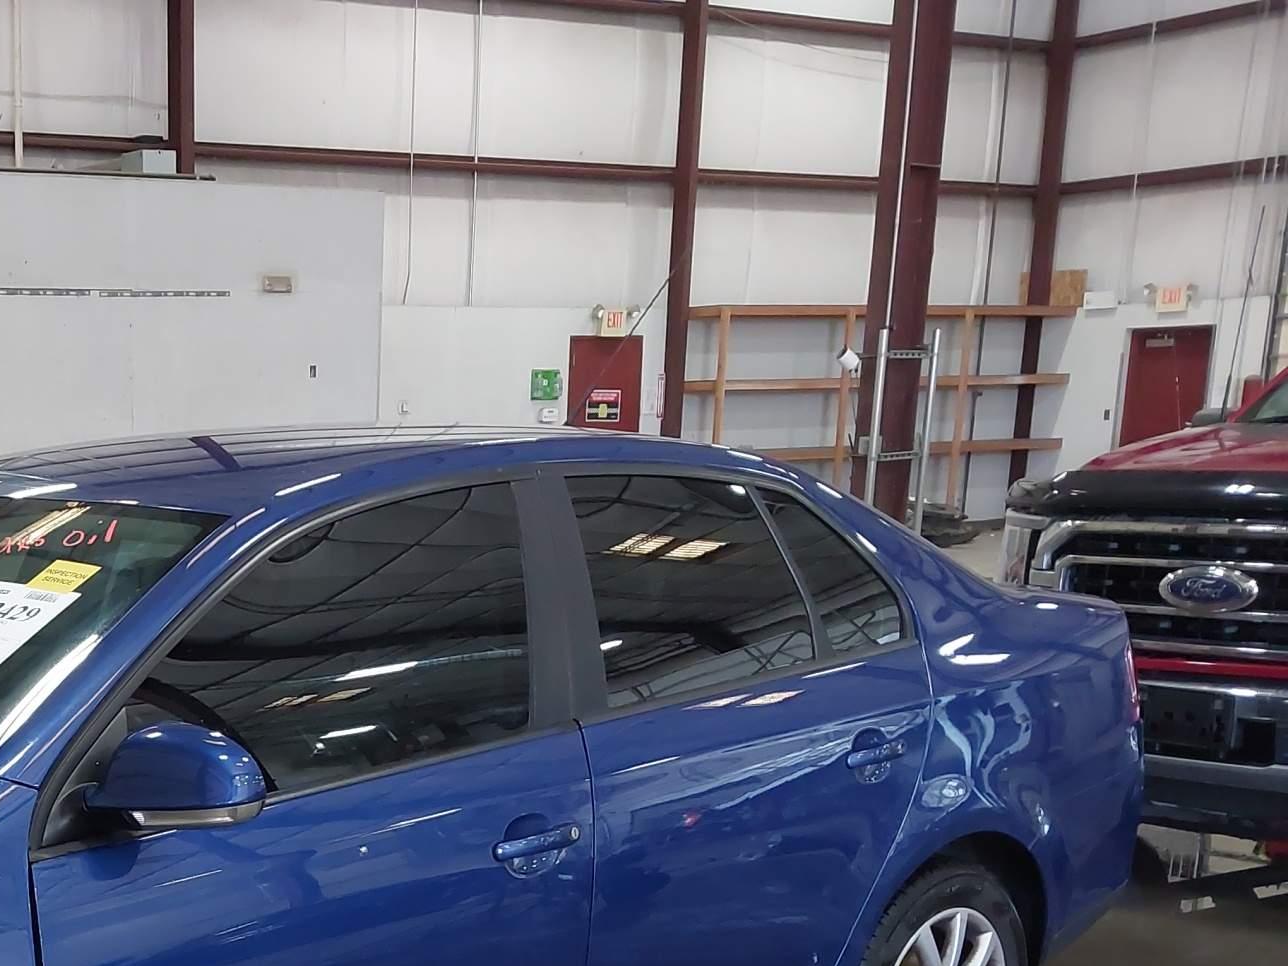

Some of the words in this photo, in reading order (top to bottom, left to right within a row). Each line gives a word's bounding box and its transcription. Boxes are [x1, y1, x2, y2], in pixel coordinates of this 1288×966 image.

[607, 311, 624, 329] EXIT
[41, 575, 76, 586] SERVICE
[45, 568, 89, 580] INSPECTION
[1181, 577, 1229, 599] Ford
